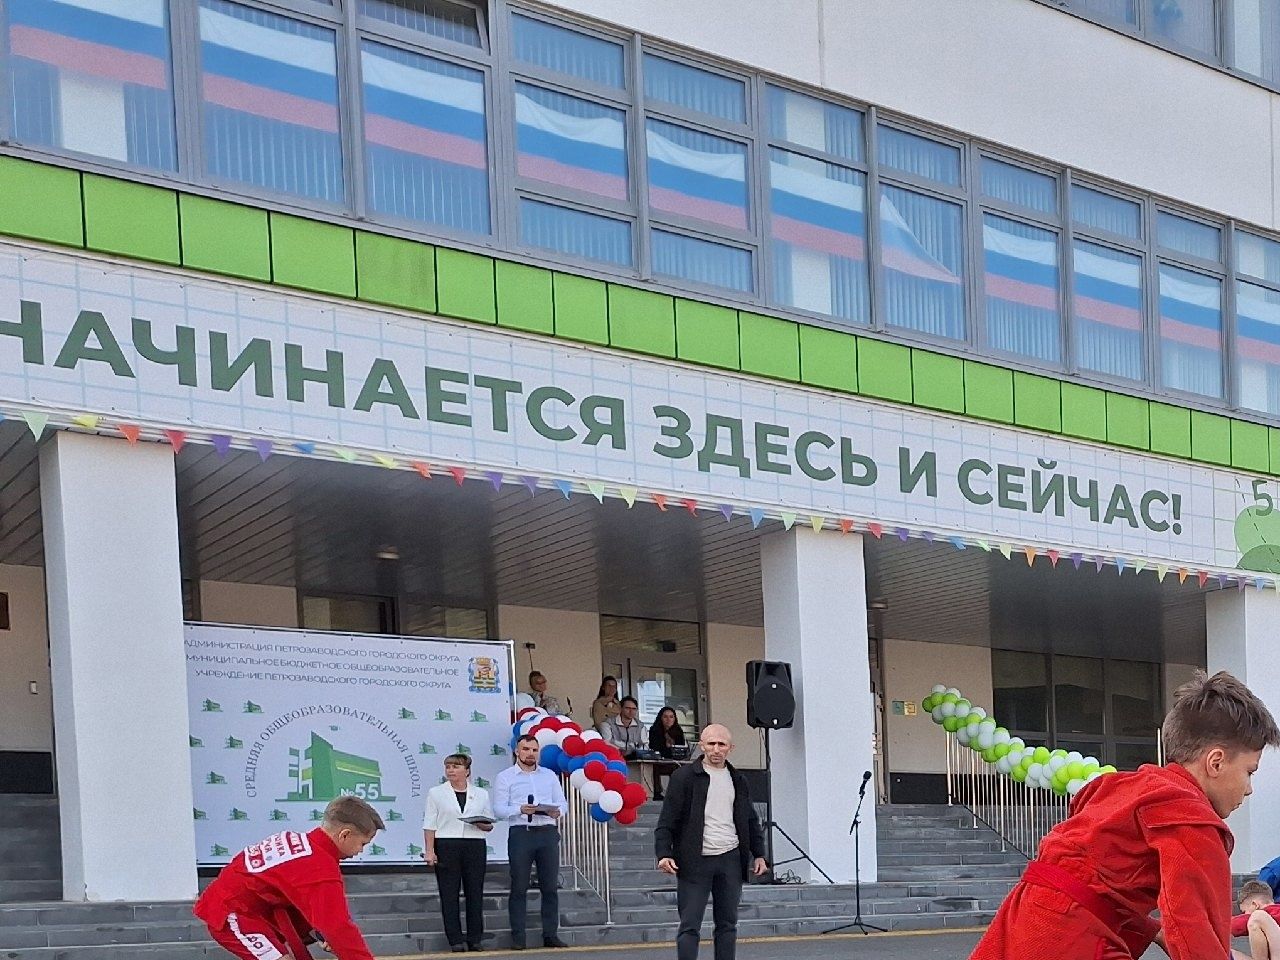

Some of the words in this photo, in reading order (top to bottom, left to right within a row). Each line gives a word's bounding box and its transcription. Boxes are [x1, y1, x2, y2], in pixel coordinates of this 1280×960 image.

[0, 299, 627, 451] НАЧИНАЕТСЯ
[653, 404, 879, 487] ЗДЕСЬ
[898, 446, 938, 498] И
[957, 457, 1183, 535] СЕЙЧАС!
[184, 639, 274, 652] АДМИНИСТРАЦИЯ
[274, 644, 368, 657] ПЕТРОЗАВОДСКОГО
[368, 649, 427, 661] ГОРОДСКОГО
[428, 653, 461, 662] ОКРУГА
[185, 653, 280, 667] МУНИЦИПАЛЬНОЕ
[280, 658, 342, 670] БЮДЖЕТНОЕ
[342, 662, 460, 677] ОБЩЕОБРАЗОВАТЕЛЬНОЕ
[195, 670, 264, 680] УЧРЕЖДЕНИЕ
[264, 672, 357, 685] ПЕТРОЗАВОДСКОГО
[359, 677, 418, 688] ГОРОДСКОГО
[418, 680, 452, 690] ОКРУГА
[244, 741, 265, 798] СРЕДНЯЯ
[260, 703, 409, 754] ОБЩЕОБРАЗОВАТЕЛЬНАЯ
[404, 753, 421, 799] ШКОЛА
